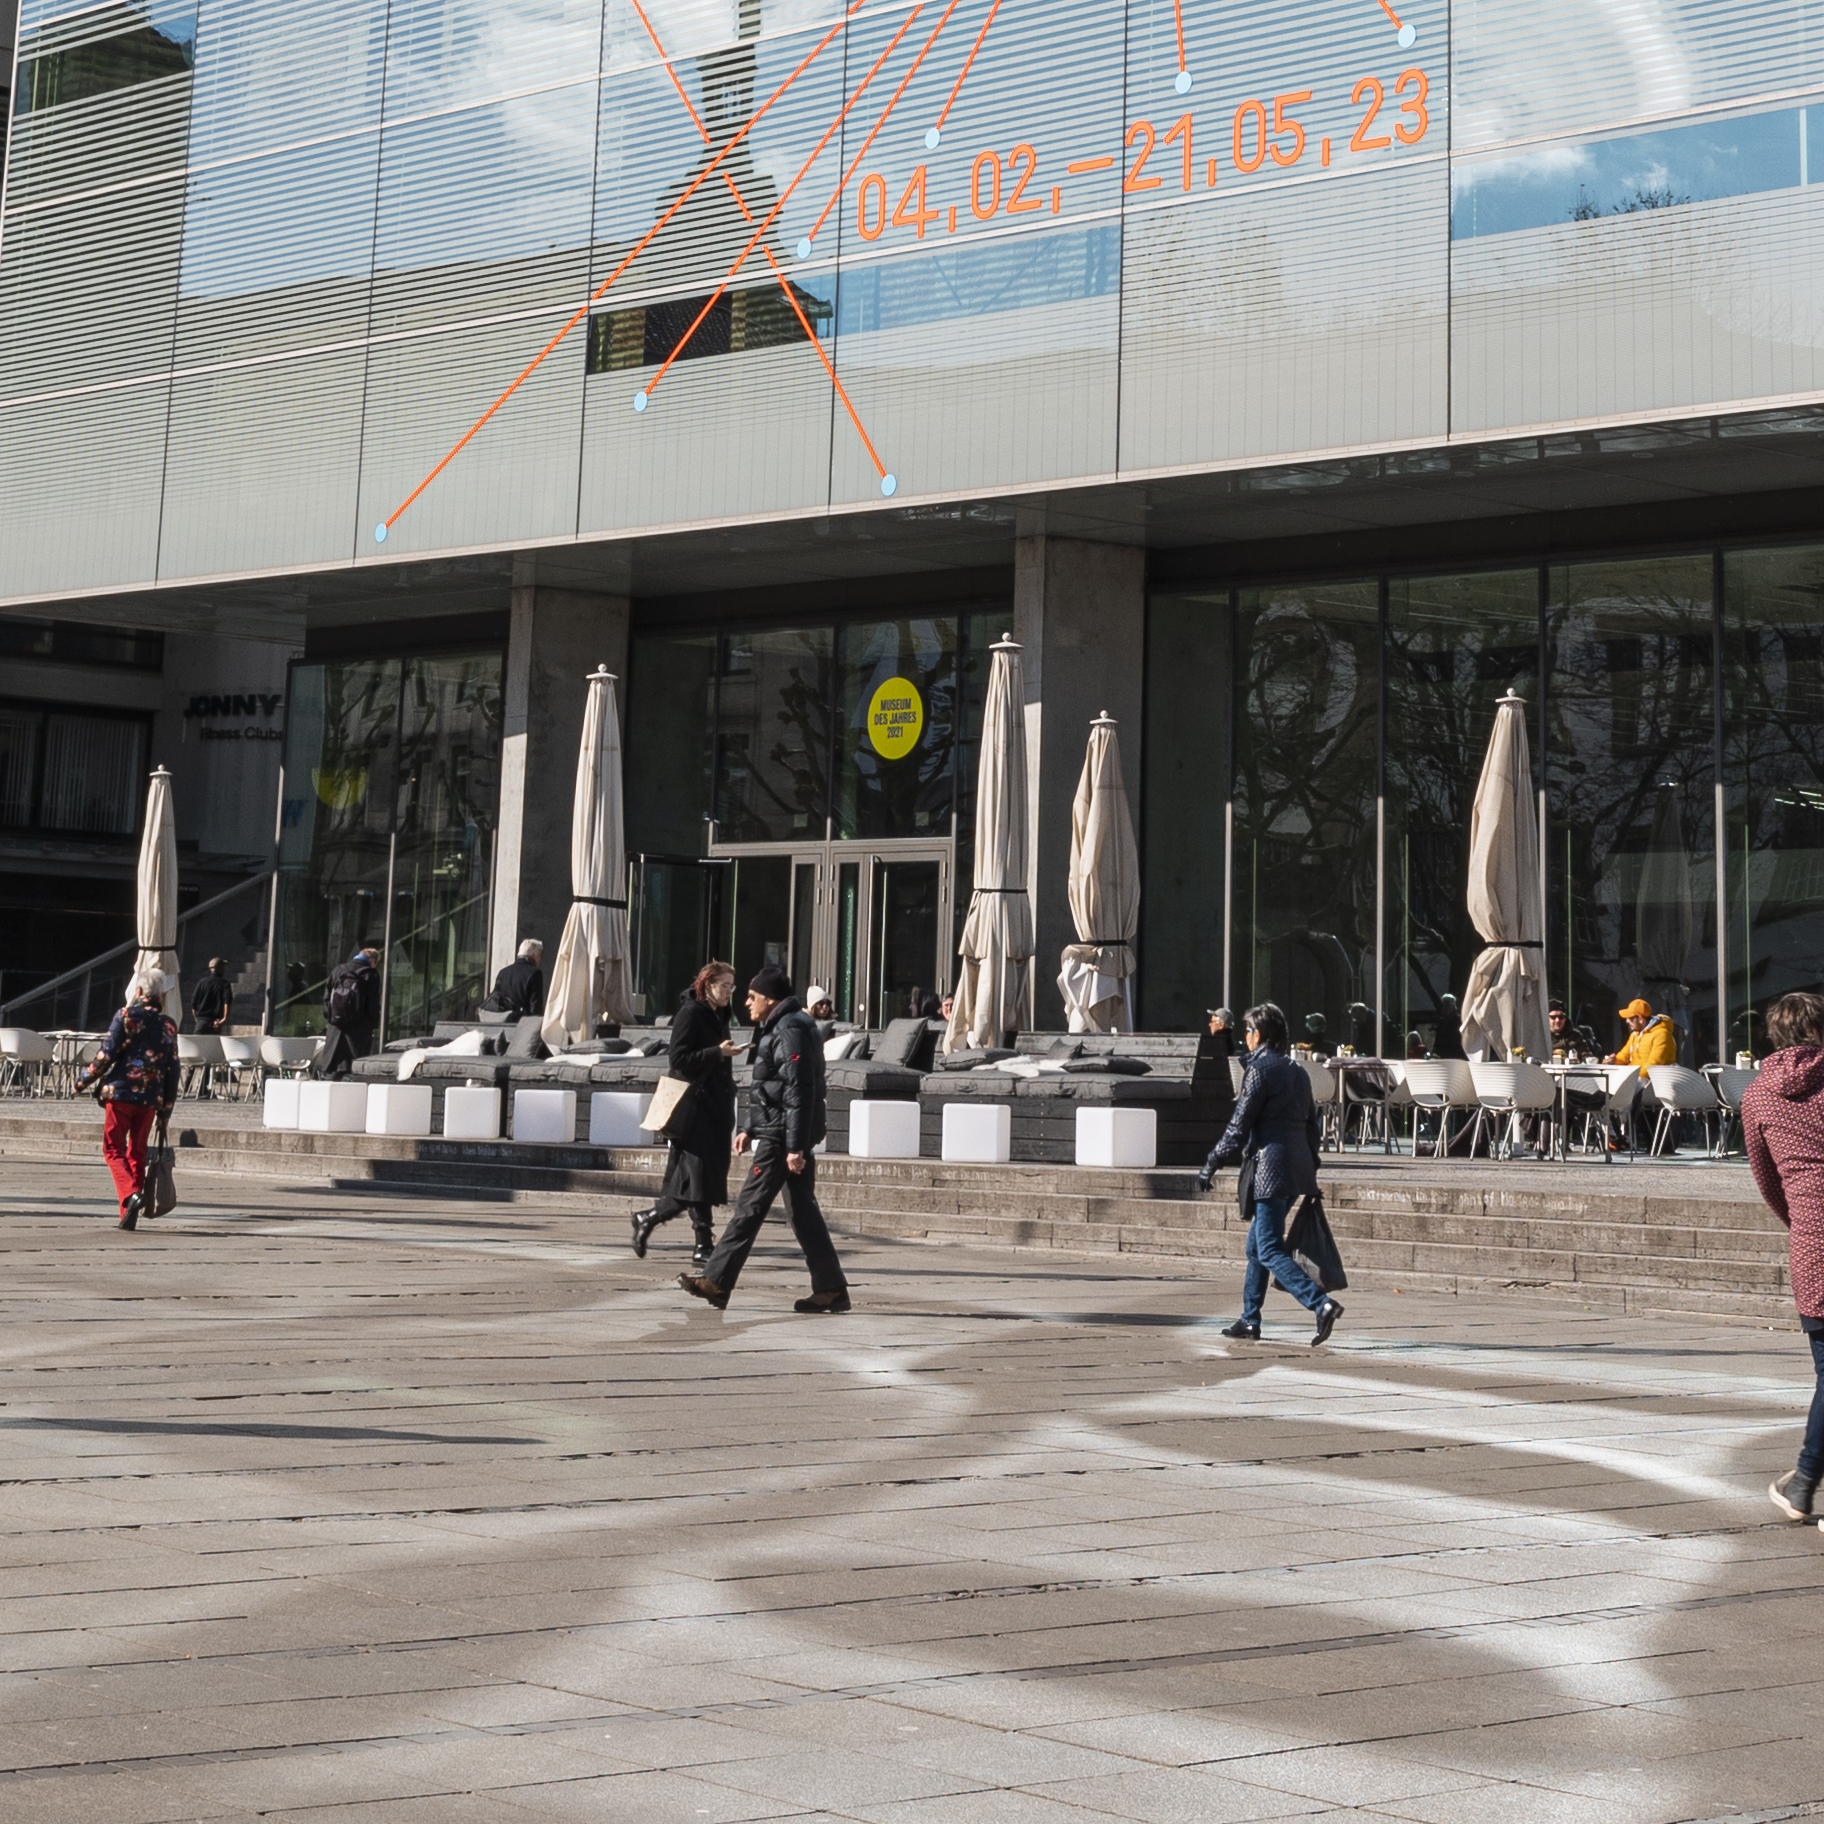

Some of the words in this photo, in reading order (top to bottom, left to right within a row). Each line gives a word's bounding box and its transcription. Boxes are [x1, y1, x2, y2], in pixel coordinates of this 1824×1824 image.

[183, 694, 282, 718] JONNY
[880, 698, 912, 711] MUSEUM
[874, 713, 888, 725] DES
[890, 712, 917, 725] JAHRES
[200, 727, 241, 741] Fitness
[887, 726, 904, 739] 2021
